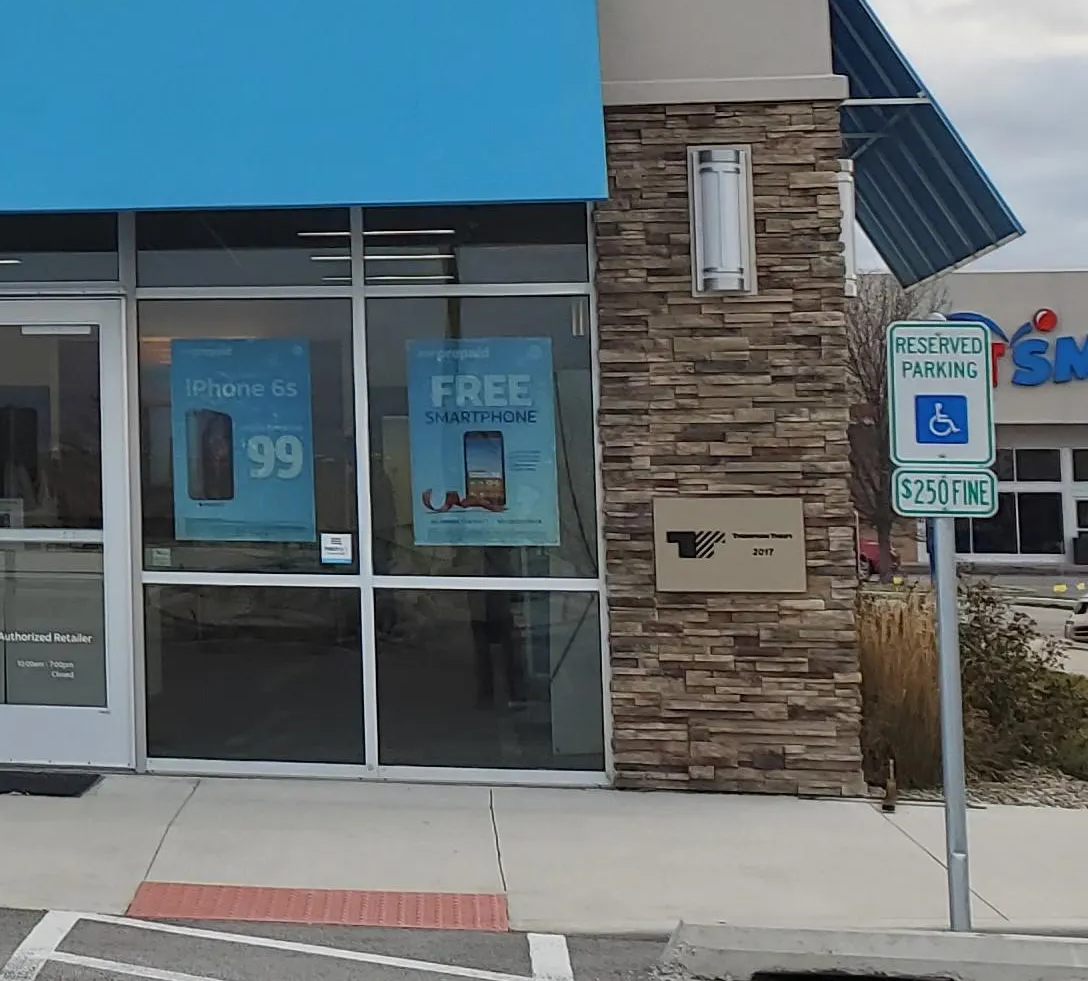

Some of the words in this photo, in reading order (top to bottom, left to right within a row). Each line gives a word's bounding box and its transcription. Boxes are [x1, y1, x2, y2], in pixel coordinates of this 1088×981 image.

[896, 336, 983, 355] RESERVED
[902, 361, 978, 379] PARKING
[271, 376, 299, 398] 6s
[431, 373, 532, 408] FREE
[425, 409, 538, 425] SMARTPHONE
[901, 478, 949, 506] $250
[953, 479, 990, 506] FINE
[752, 548, 774, 556] 2017
[54, 632, 93, 643] Retailer
